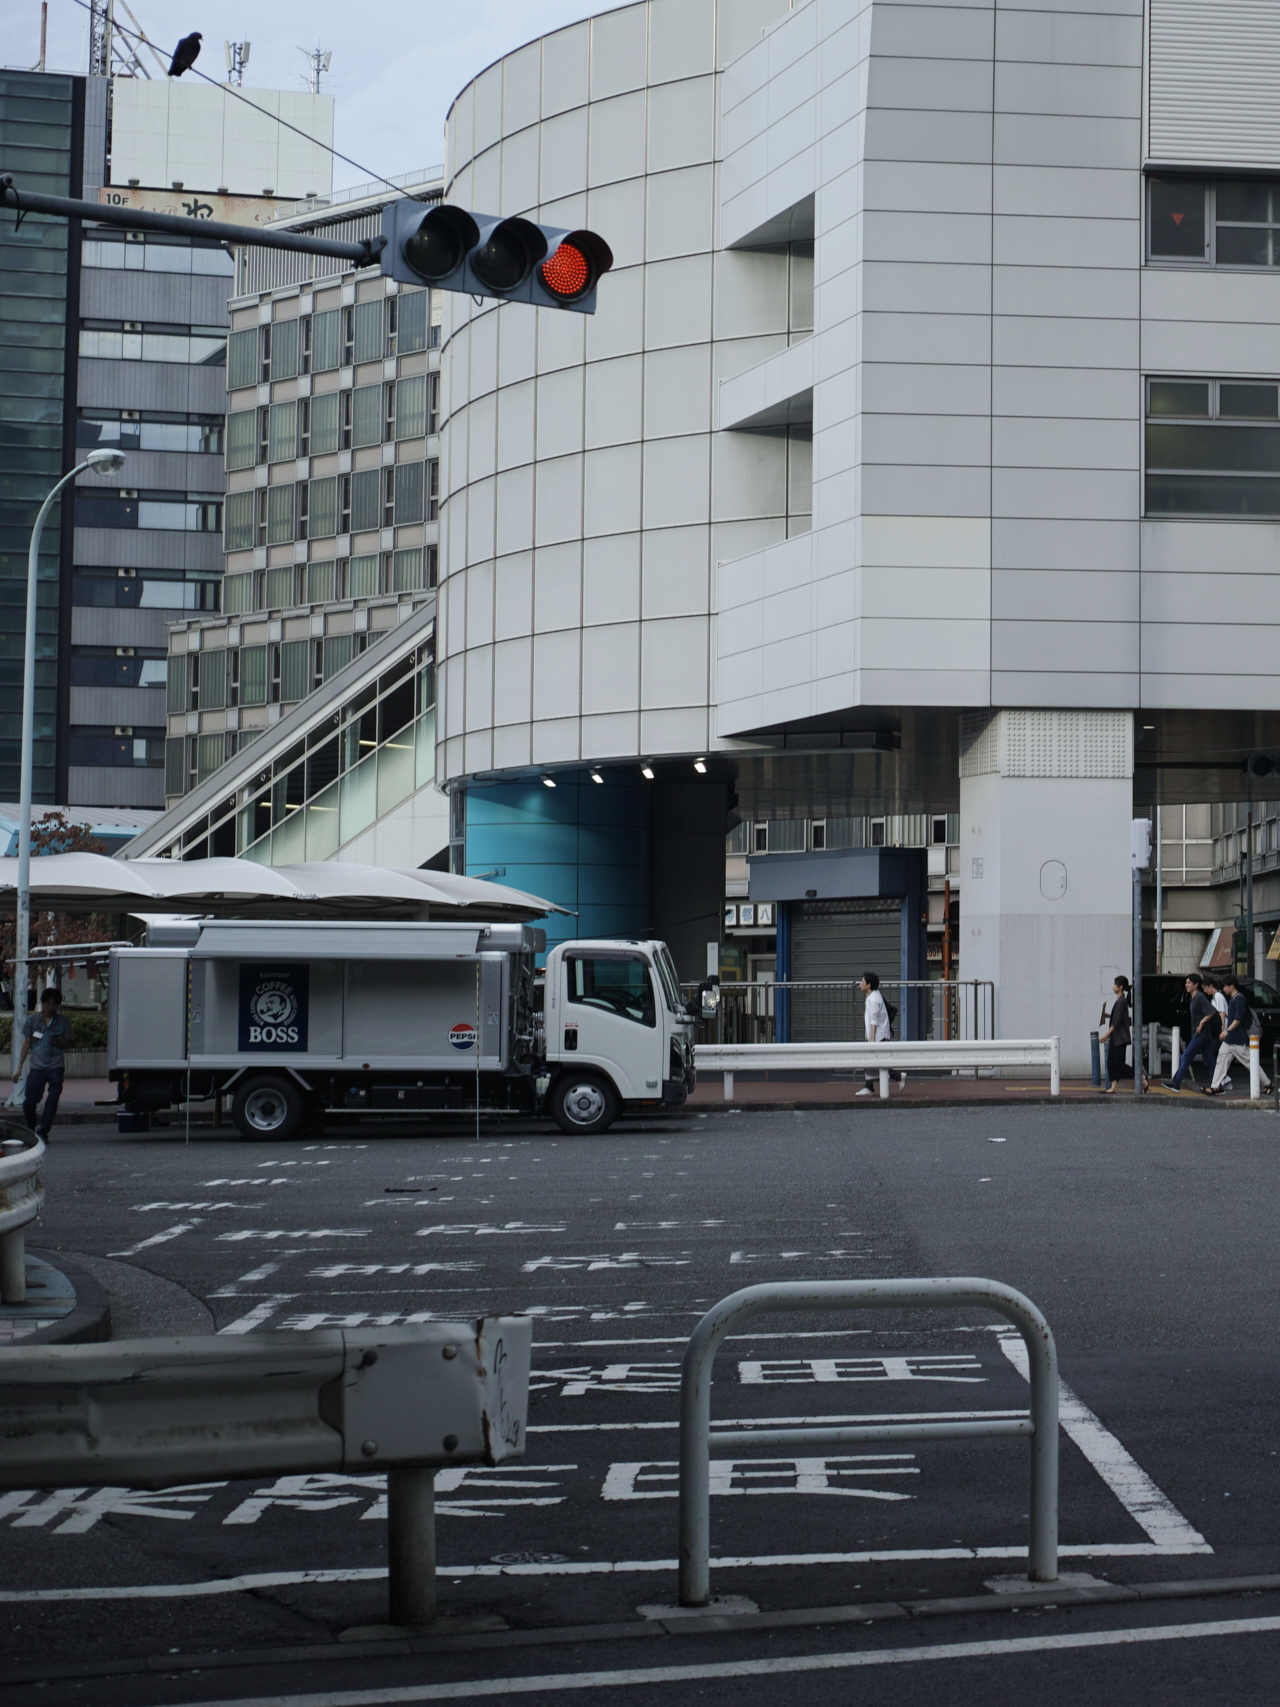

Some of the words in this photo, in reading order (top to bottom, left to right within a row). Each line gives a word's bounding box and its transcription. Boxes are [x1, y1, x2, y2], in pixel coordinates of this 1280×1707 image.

[105, 193, 129, 206] 10F
[255, 981, 294, 995] COFFEE
[248, 1026, 299, 1043] BOSS
